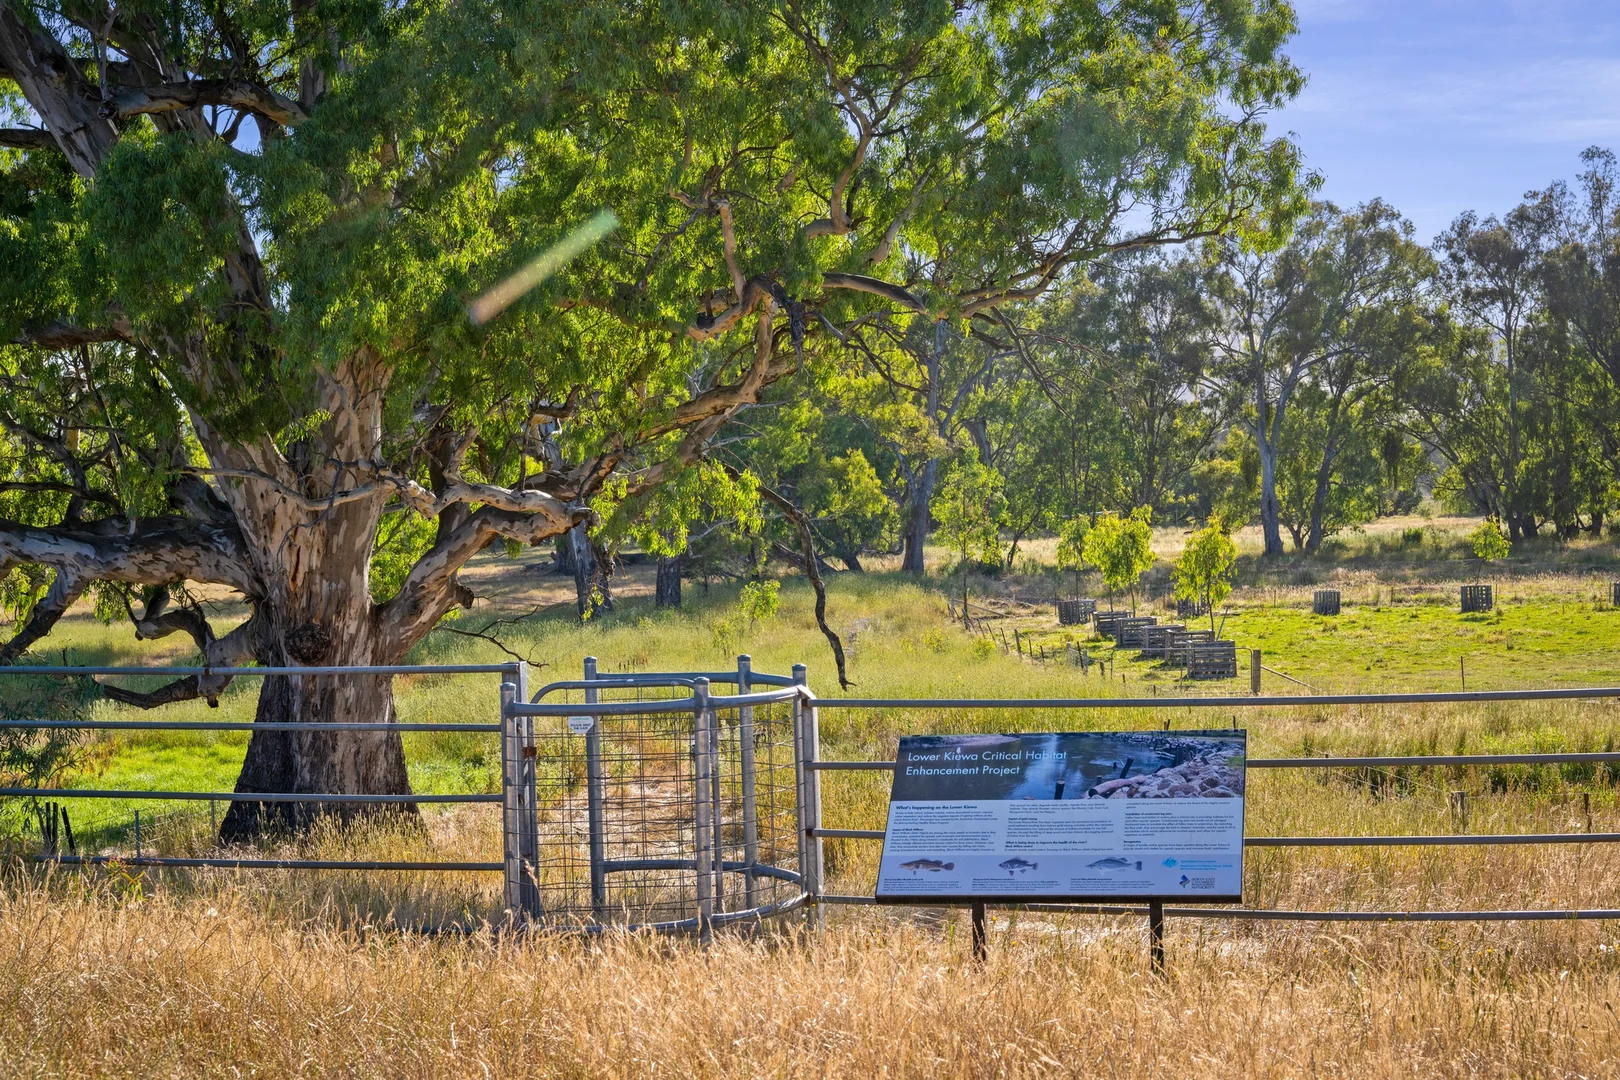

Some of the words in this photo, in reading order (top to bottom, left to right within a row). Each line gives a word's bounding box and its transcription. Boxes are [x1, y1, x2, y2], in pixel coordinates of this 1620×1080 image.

[908, 752, 940, 762] Lower
[944, 752, 978, 761] Kiewa
[982, 750, 1022, 760] Critical
[1026, 750, 1067, 760] Habitat
[906, 766, 979, 776] Enhancement
[982, 765, 1020, 776] Project
